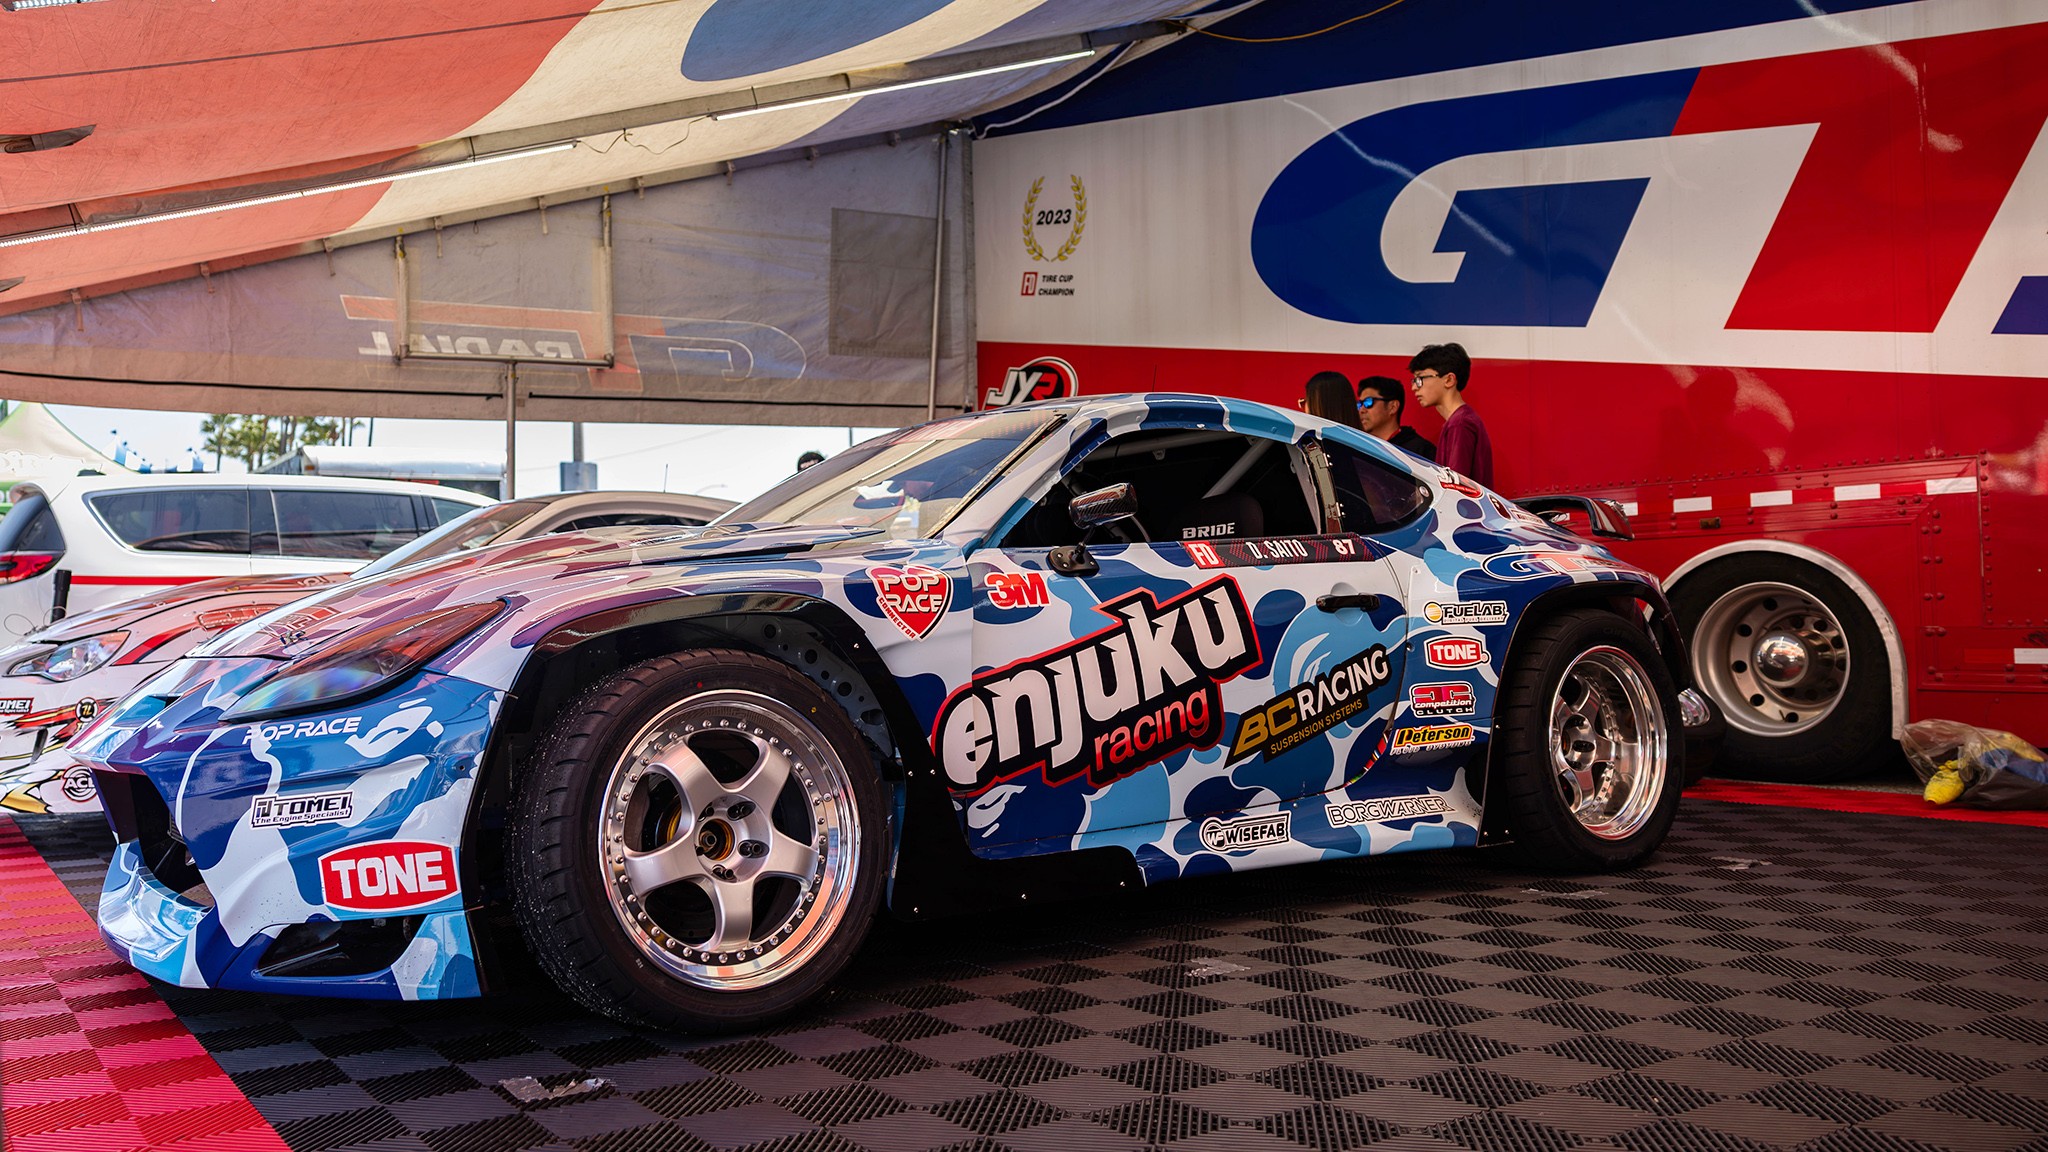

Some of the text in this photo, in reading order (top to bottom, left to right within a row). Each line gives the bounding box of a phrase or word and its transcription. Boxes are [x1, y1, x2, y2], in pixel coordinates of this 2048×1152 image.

[1036, 209, 1072, 225] 2023
[1042, 275, 1073, 283] TIRE CUP
[1038, 288, 1075, 296] CHAMPION
[1182, 522, 1236, 539] BRIDE
[1186, 538, 1356, 566] FD D. SAITO 87
[877, 574, 940, 592] POP
[986, 571, 1050, 609] 3M
[883, 594, 943, 613] RACE
[1443, 605, 1503, 618] FUELAB
[878, 597, 916, 639] CONNECTOR
[1433, 644, 1477, 661] TONE
[942, 586, 1247, 785] enjuku
[1414, 699, 1473, 709] competition
[1415, 707, 1473, 715] CLUTCH
[242, 716, 363, 745] POP RACE
[1094, 688, 1210, 771] racing
[1270, 699, 1363, 755] SUSPENSION SYSTEMS
[1397, 727, 1470, 745] Peterson
[273, 796, 349, 816] TOMEI
[1331, 798, 1448, 824] BORGWARNER
[254, 809, 349, 824] The Engine Specialist
[1225, 822, 1286, 844] WISEFAB
[330, 850, 447, 900] TONE
